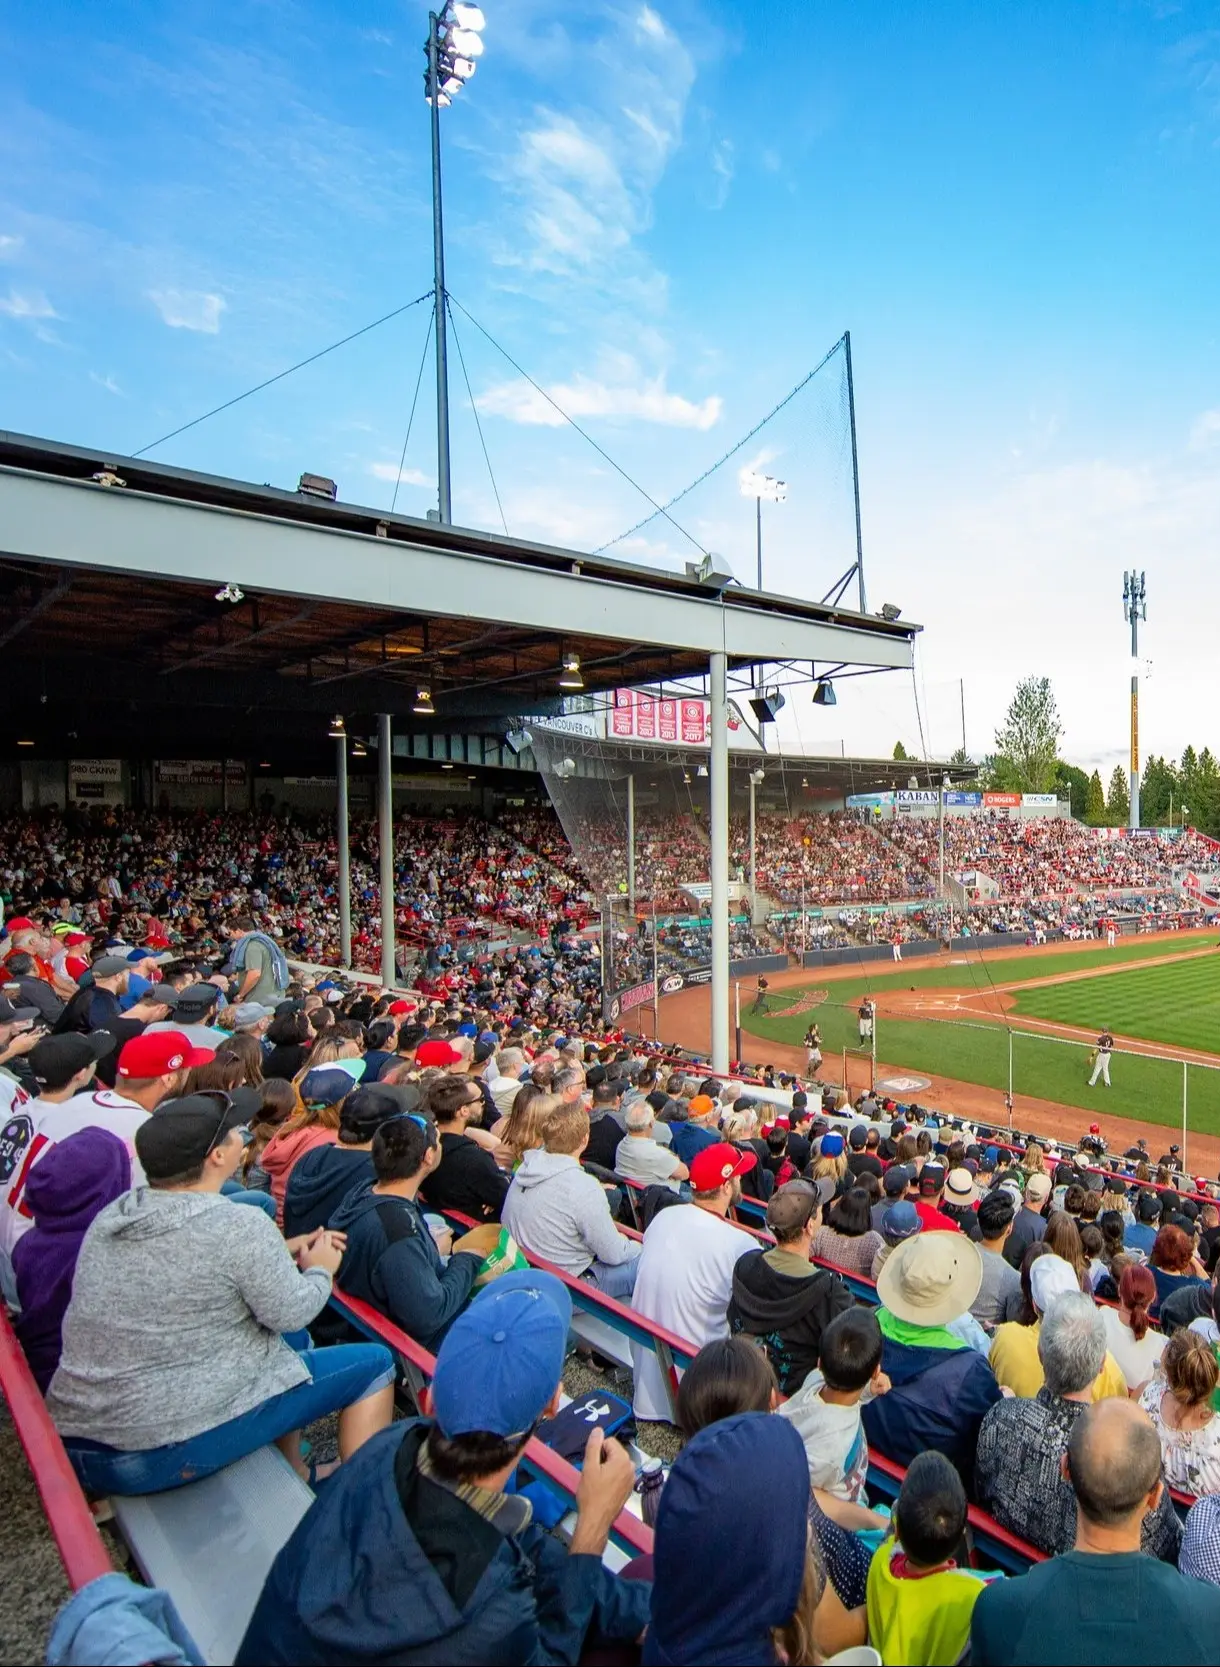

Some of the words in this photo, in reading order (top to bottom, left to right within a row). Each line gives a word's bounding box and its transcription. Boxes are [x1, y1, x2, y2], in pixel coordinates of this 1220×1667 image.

[544, 719, 582, 733] VANCOUVER
[617, 724, 629, 733] 2011
[639, 727, 653, 736] 2012
[661, 730, 675, 739] 2013
[685, 733, 702, 741] 2017
[71, 765, 87, 773] 980
[90, 766, 117, 775] CKNW
[899, 791, 938, 801] KABAN
